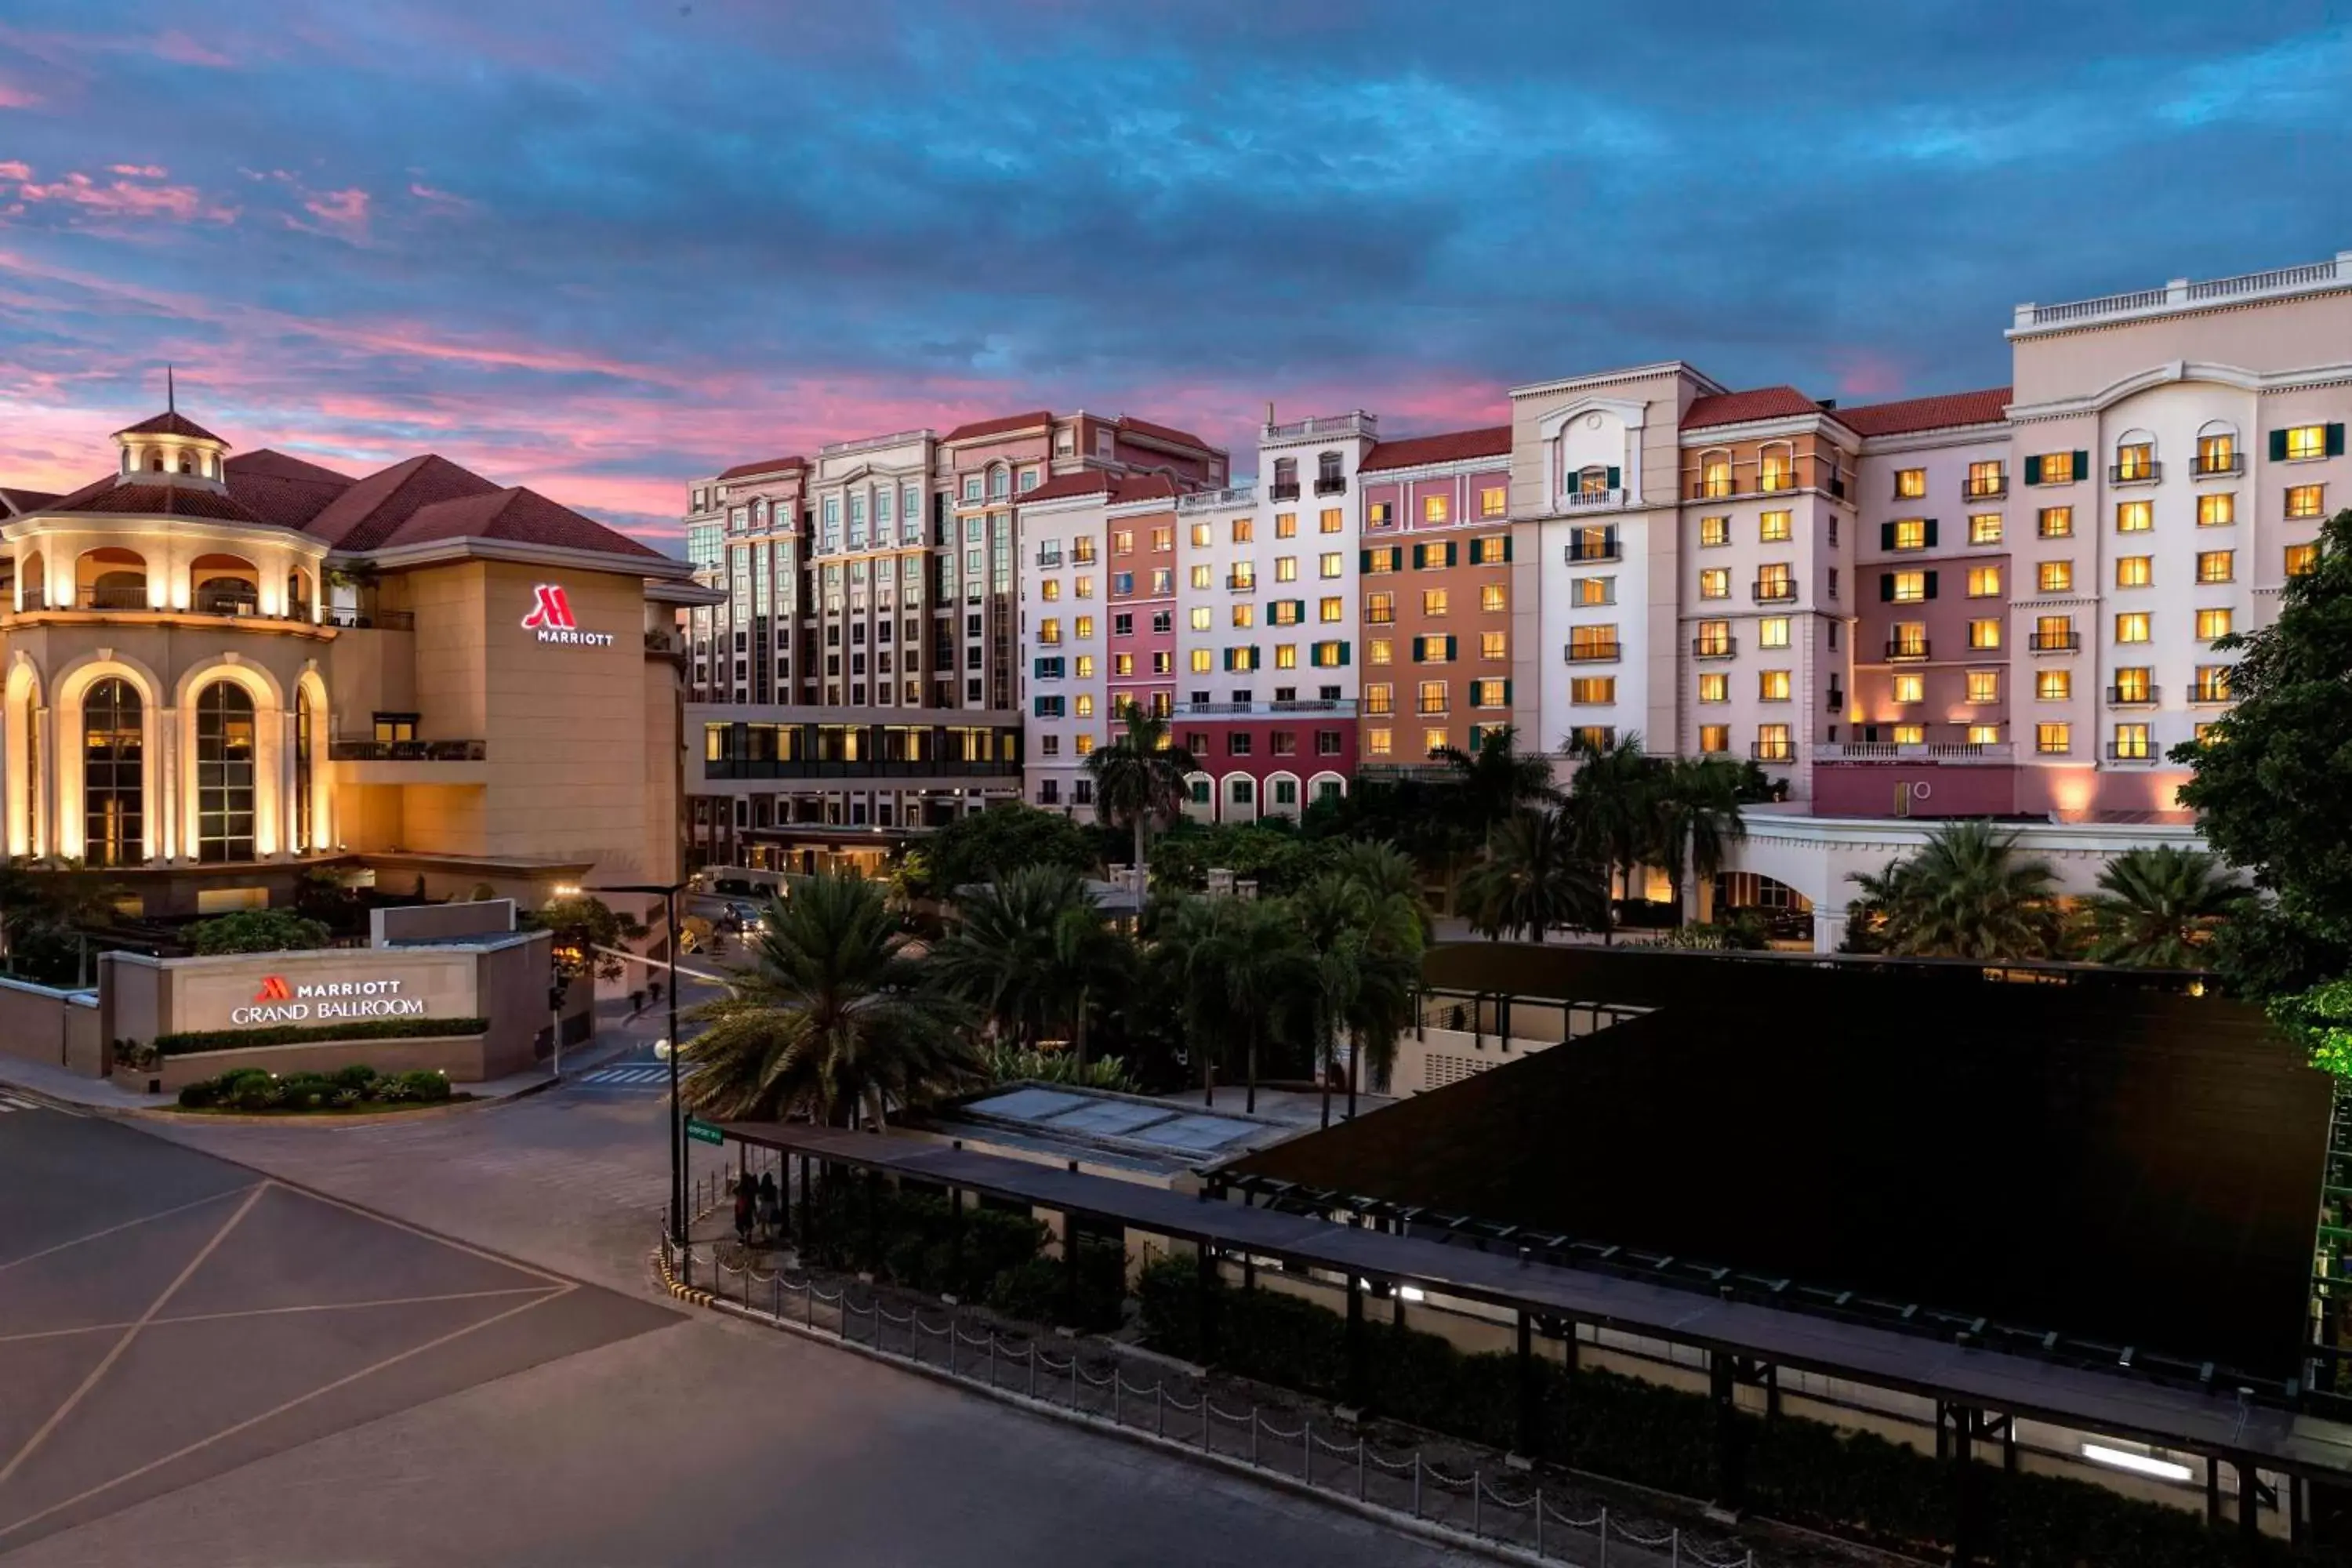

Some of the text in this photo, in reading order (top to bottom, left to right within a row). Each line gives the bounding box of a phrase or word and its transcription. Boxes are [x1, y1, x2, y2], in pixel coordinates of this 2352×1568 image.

[538, 630, 613, 646] MARRIOTT
[297, 981, 401, 997] MARRIOTT
[232, 999, 423, 1024] GRAND BALLROOM
